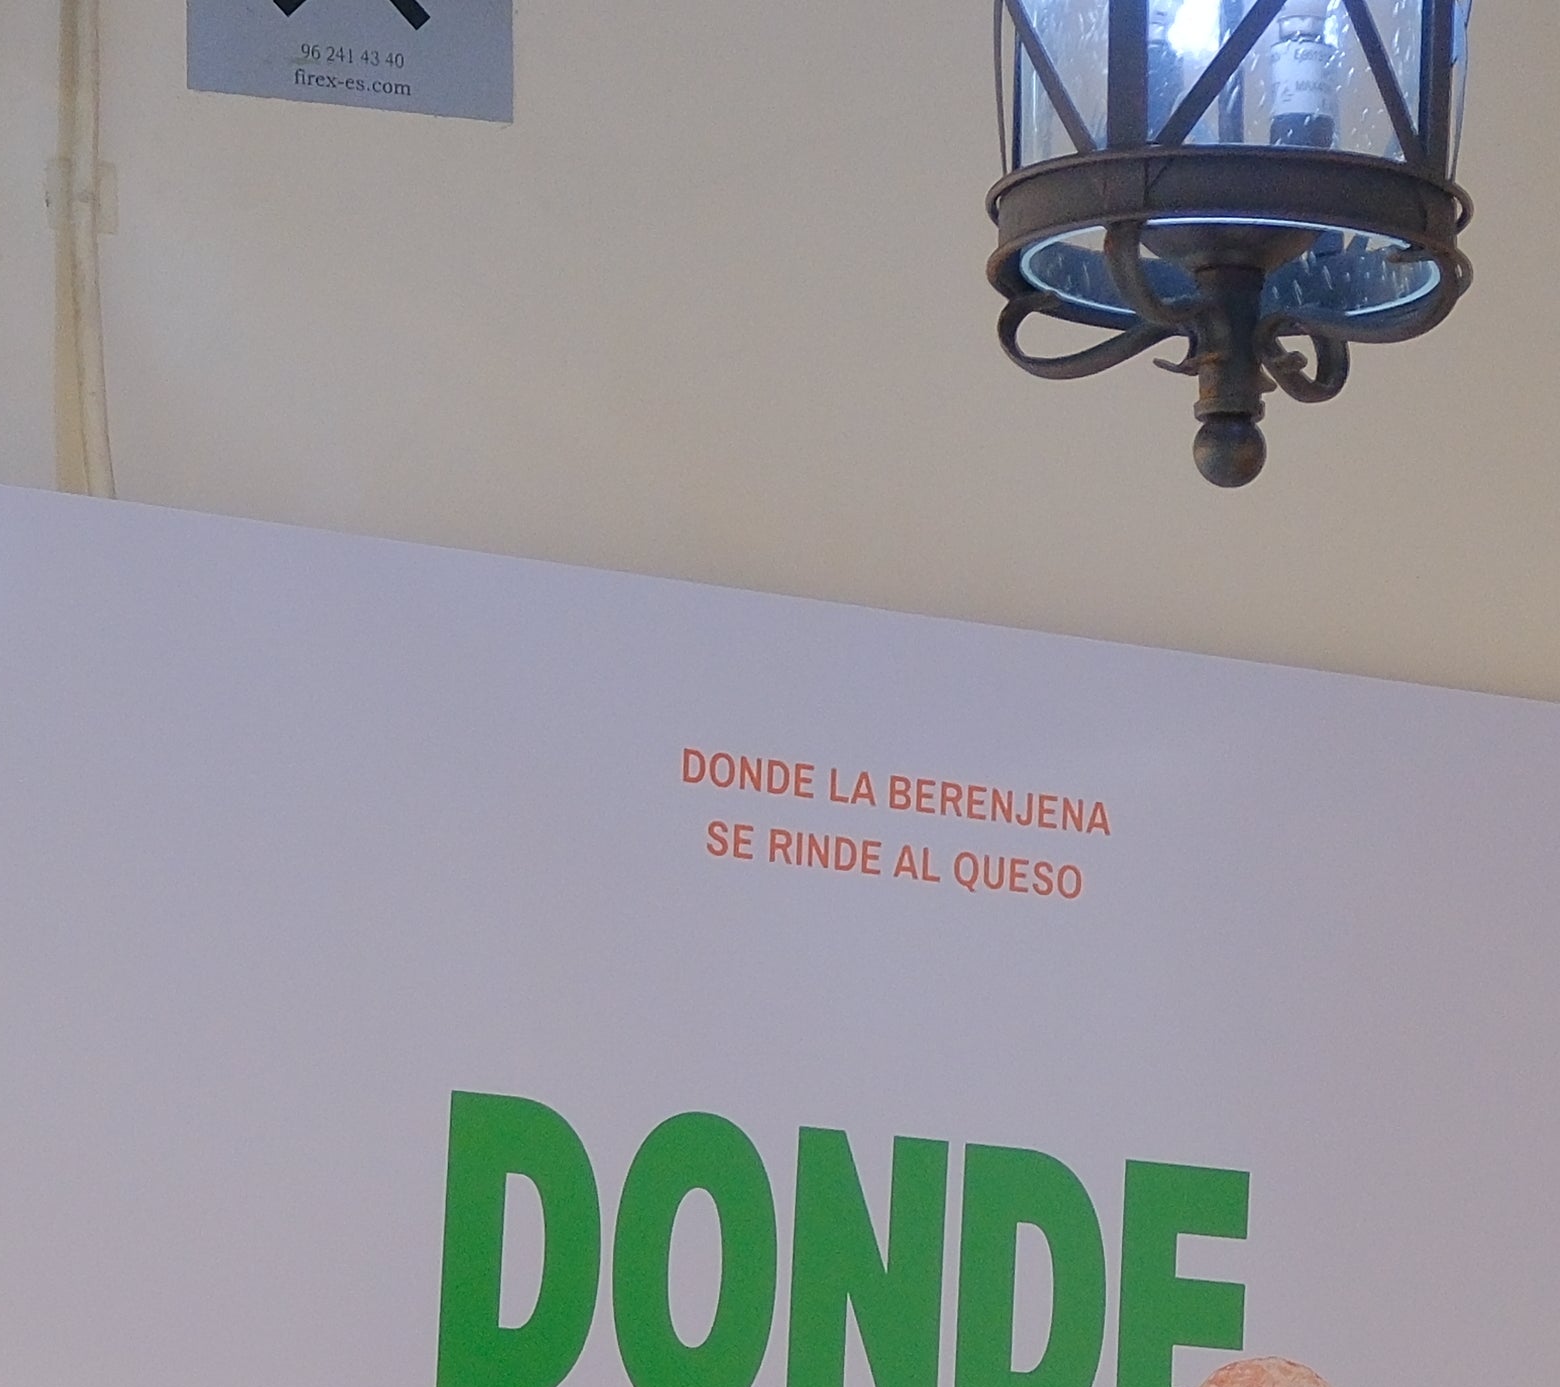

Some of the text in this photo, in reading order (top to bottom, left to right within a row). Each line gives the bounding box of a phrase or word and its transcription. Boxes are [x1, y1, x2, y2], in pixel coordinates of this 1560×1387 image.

[294, 68, 411, 96] firex-es.com
[301, 43, 405, 69] 96 241 43 40
[682, 747, 1112, 836] DONDE LA BERENJENA
[706, 820, 1083, 900] SE RINDE AL QUESO
